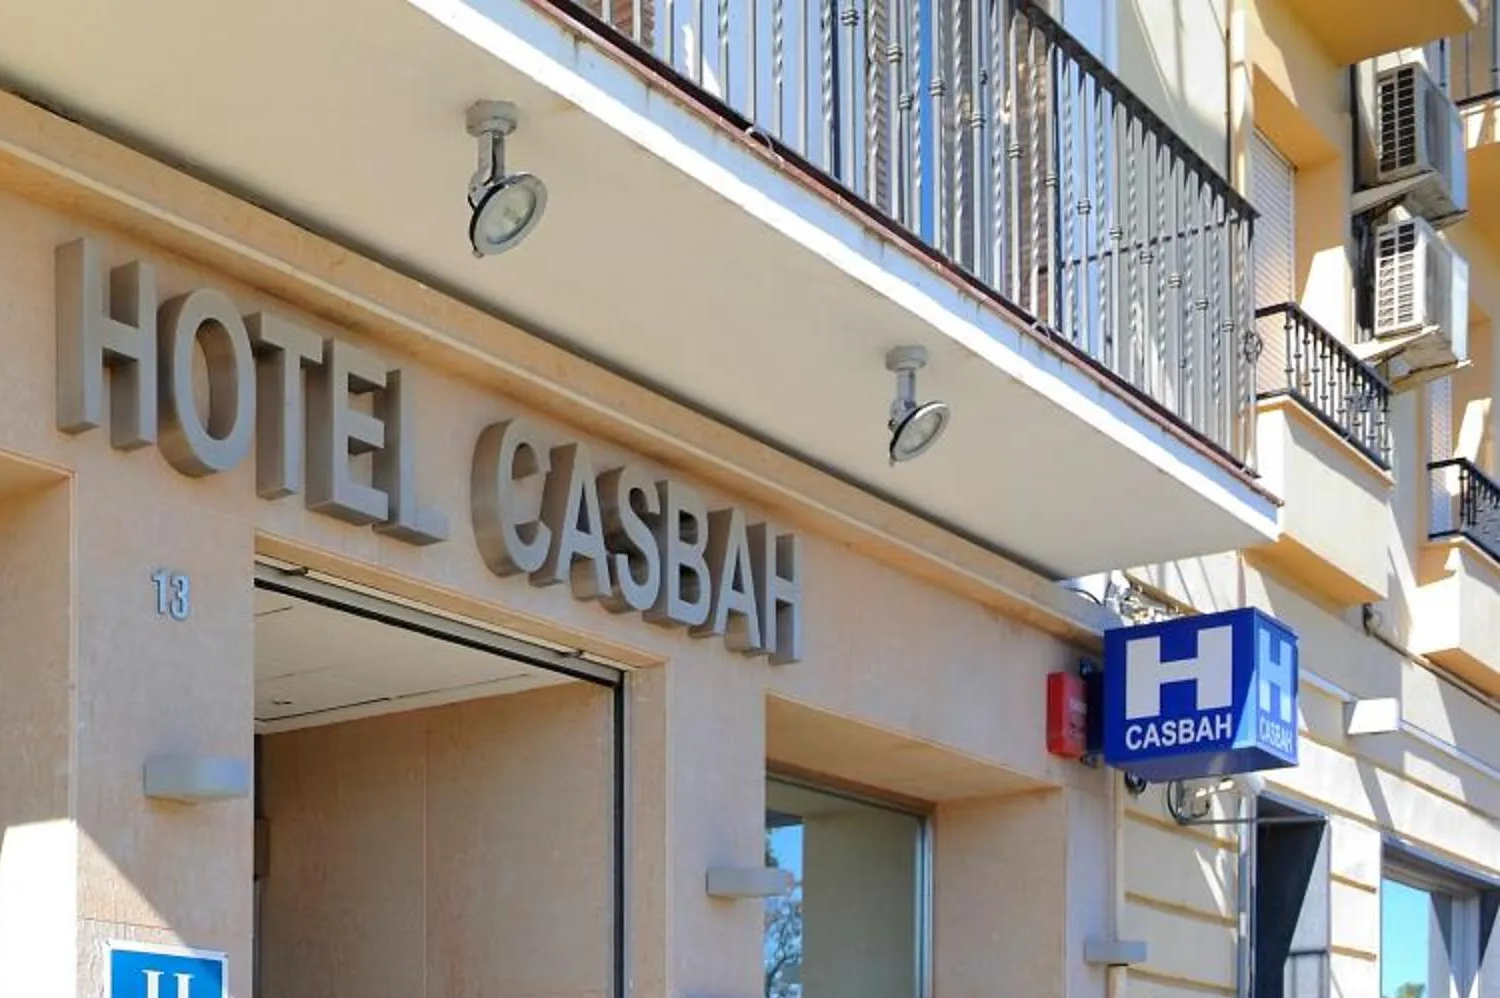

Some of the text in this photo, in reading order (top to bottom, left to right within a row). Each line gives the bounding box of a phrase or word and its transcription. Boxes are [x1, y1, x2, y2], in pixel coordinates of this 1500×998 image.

[55, 237, 803, 665] HOTEL CASBAH
[151, 571, 190, 621] 13
[1125, 624, 1233, 720] H
[1259, 628, 1293, 724] H
[1125, 713, 1233, 751] CASBAH
